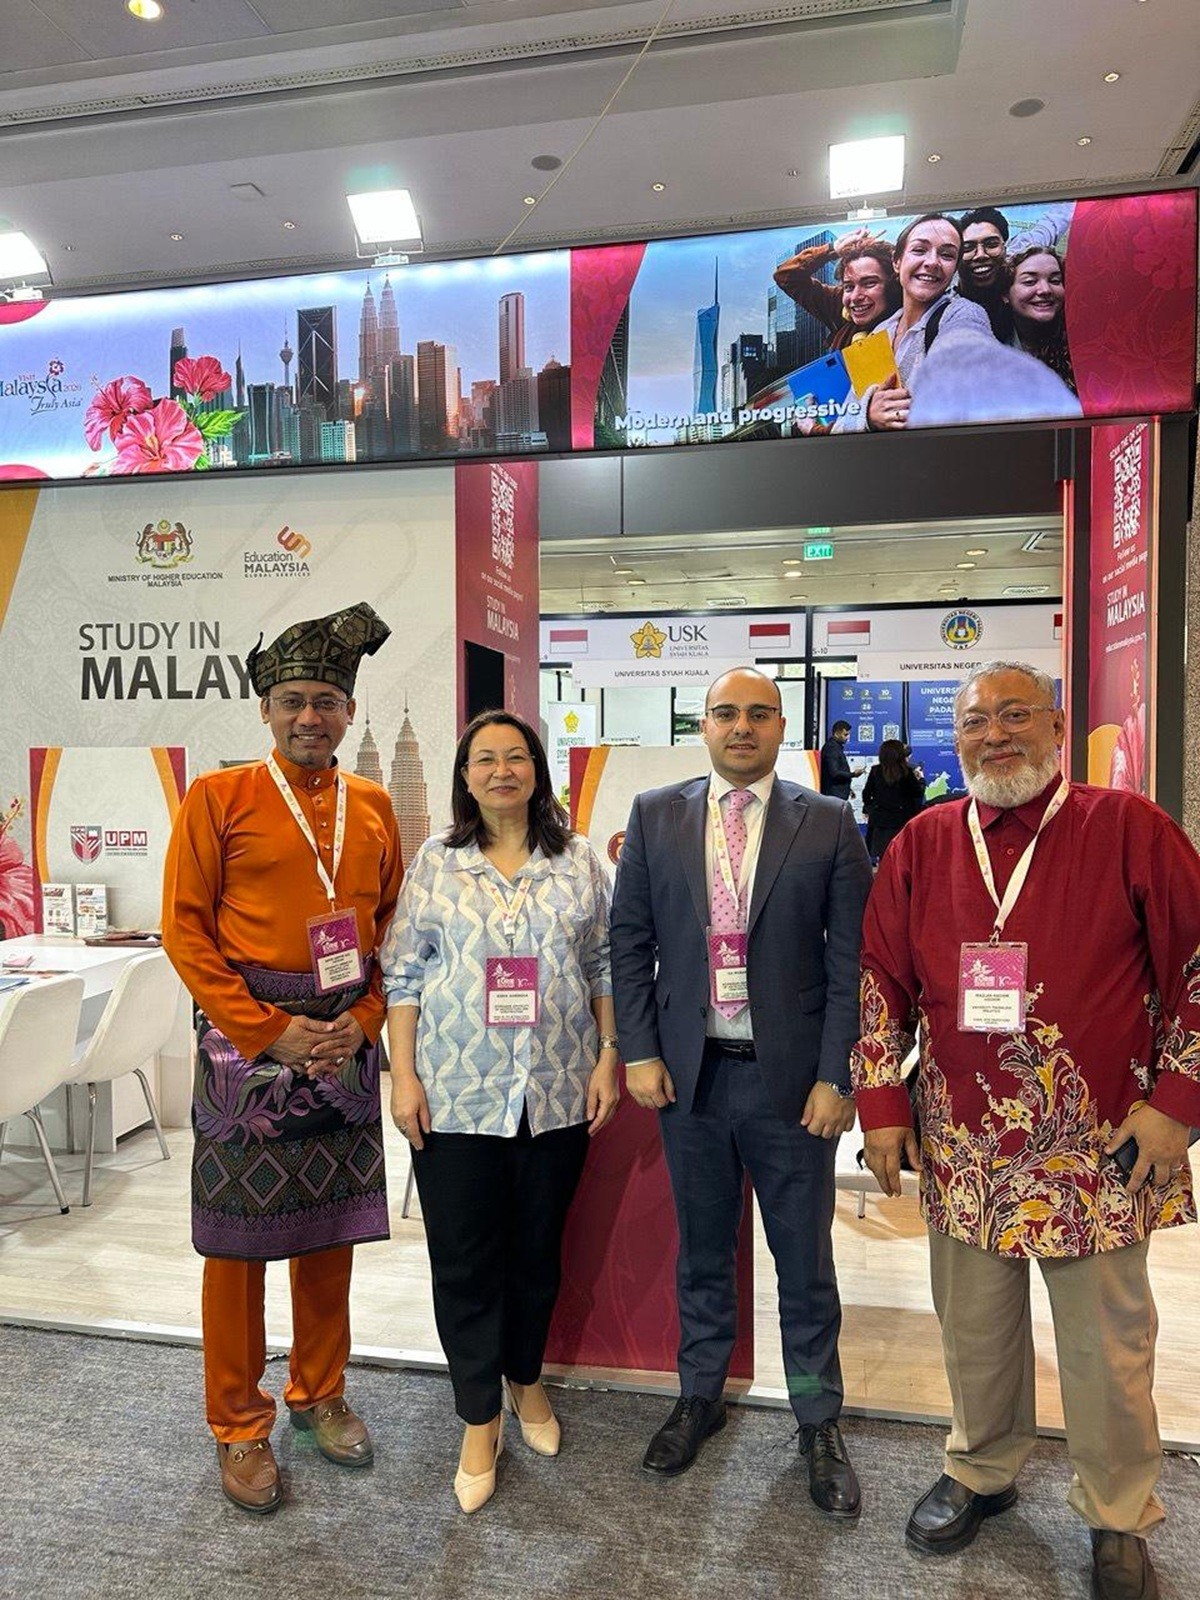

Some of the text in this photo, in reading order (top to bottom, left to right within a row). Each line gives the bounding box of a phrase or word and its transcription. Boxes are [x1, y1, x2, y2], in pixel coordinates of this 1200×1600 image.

[615, 399, 860, 430] Modern and progressive
[244, 551, 293, 562] Education
[807, 544, 832, 557] EXIT
[244, 562, 310, 573] MALAYSIA
[181, 572, 223, 580] EDUCATION
[1107, 591, 1145, 628] MALAYSIA
[487, 609, 519, 641] MALAYSIA
[79, 621, 220, 651] STUDY IN
[668, 624, 708, 642] USK
[614, 669, 660, 677] UNIVERSITAS
[661, 669, 682, 677] SYIAH
[899, 663, 952, 671] UNIVERSITAS
[105, 832, 147, 846] UPM
